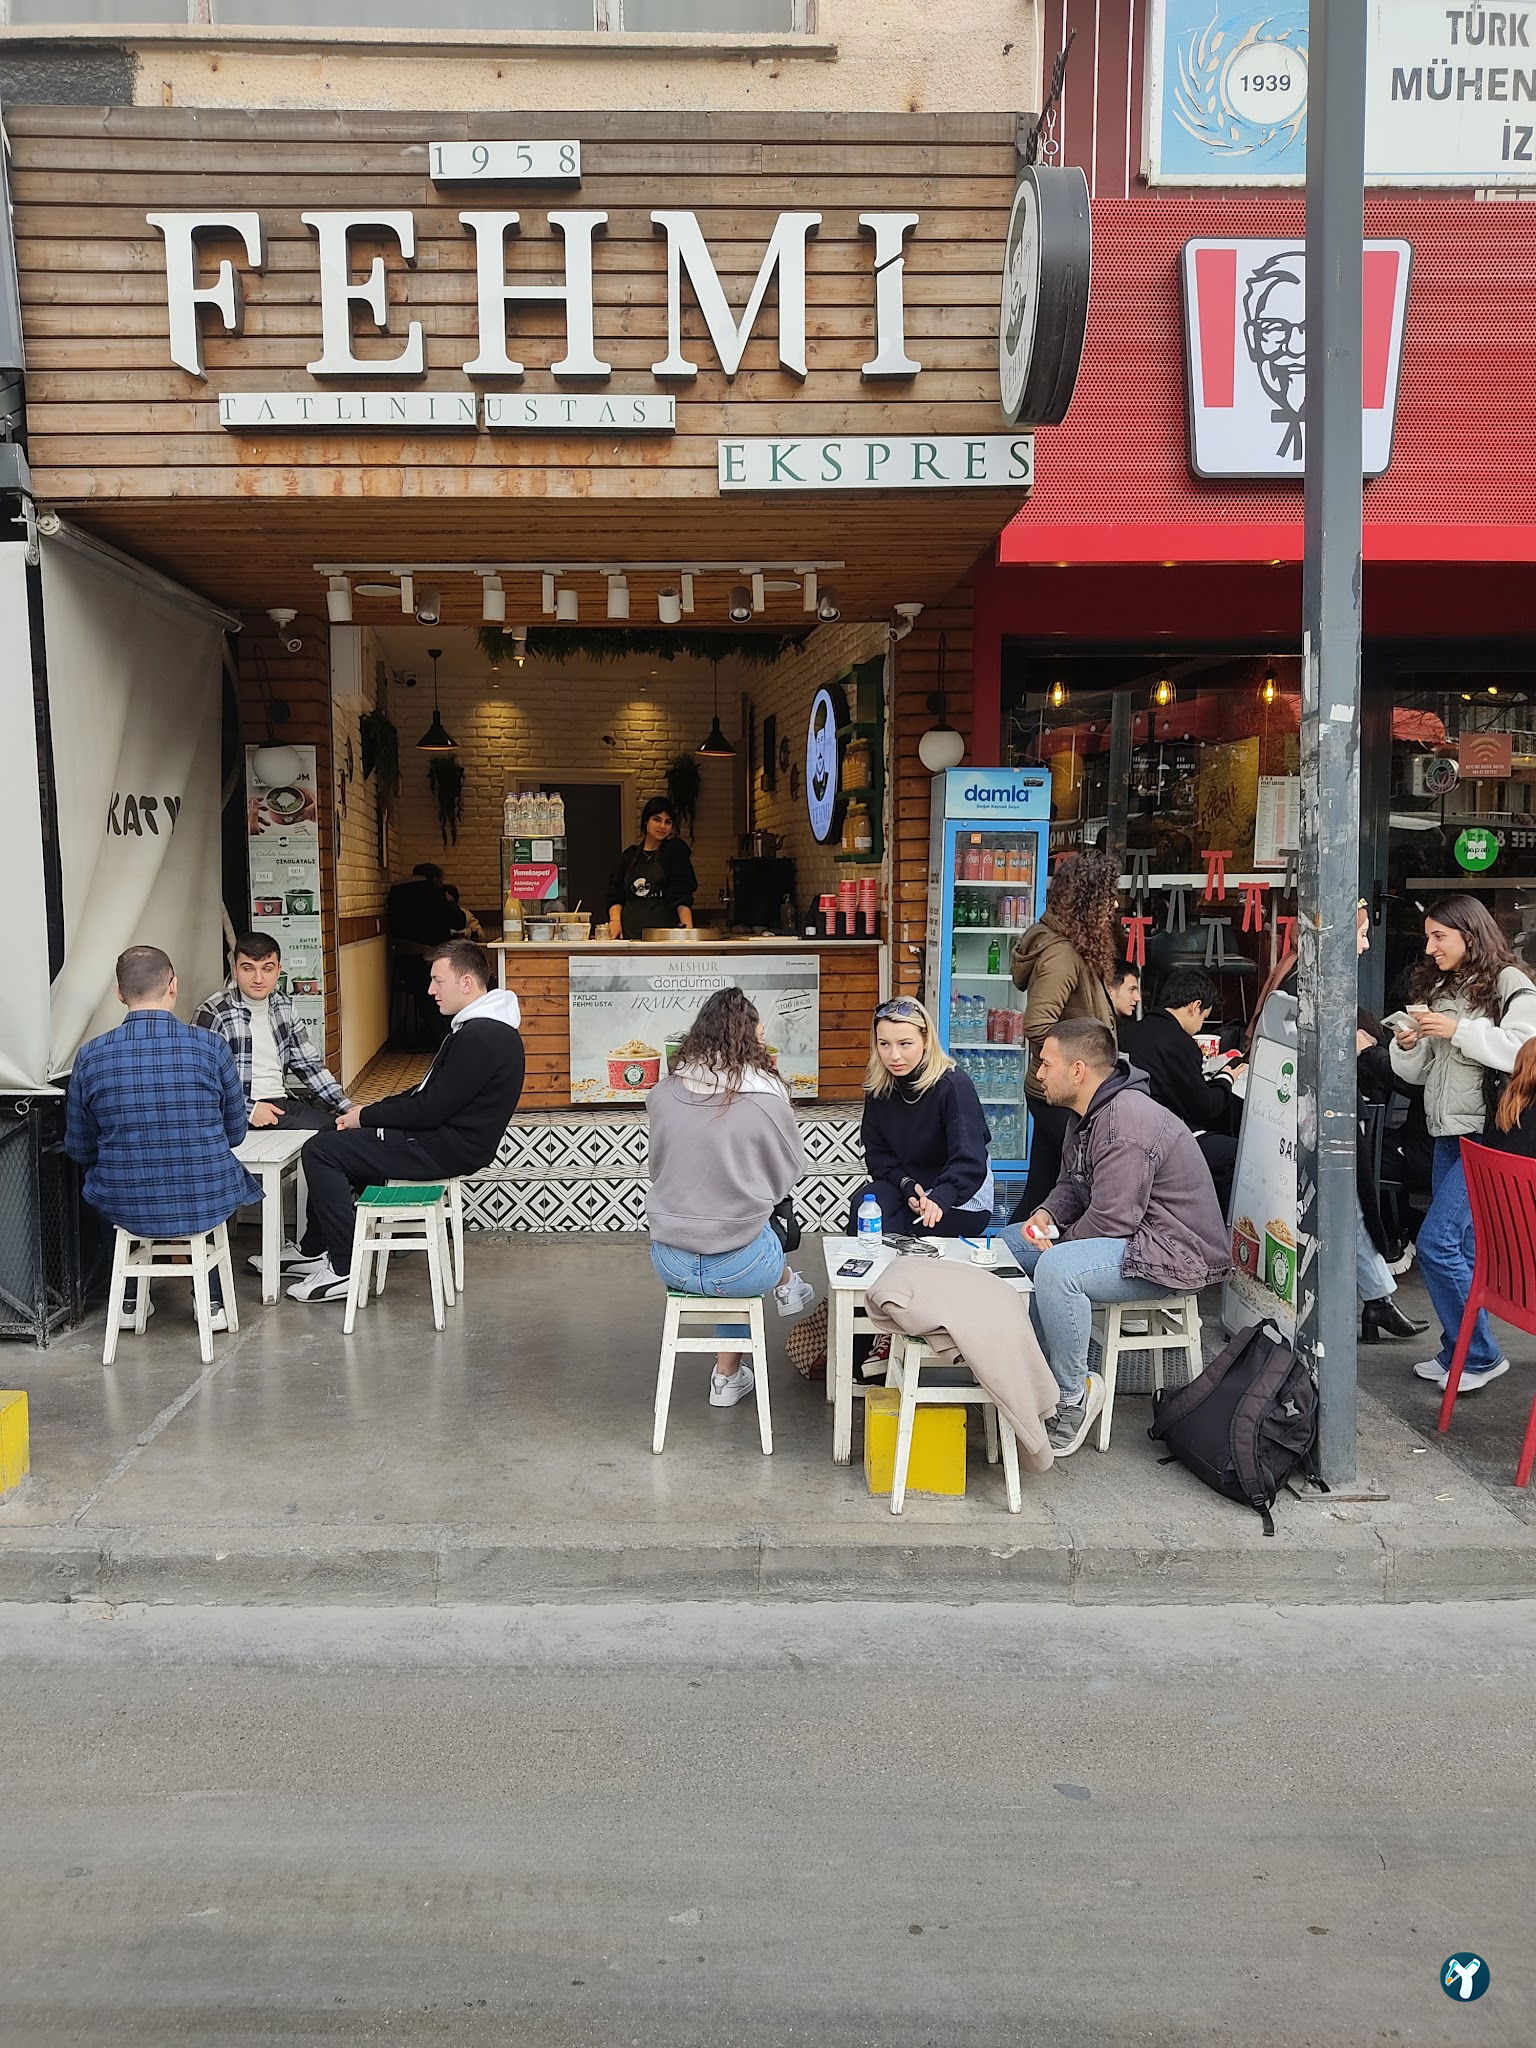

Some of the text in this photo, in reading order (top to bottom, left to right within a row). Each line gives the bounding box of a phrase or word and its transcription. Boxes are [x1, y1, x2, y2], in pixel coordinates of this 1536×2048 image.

[1446, 4, 1530, 47] TÜRK
[1240, 74, 1291, 92] 1939
[1391, 58, 1536, 102] MÜHEN
[432, 143, 578, 176] 1958
[219, 396, 675, 423] TATLININ USTASI
[722, 440, 1030, 483] EKSPRES
[964, 784, 1029, 803] damla
[513, 868, 550, 877] Yemeksepeti
[669, 961, 719, 973] MEŞHUR
[653, 976, 726, 988] dondurmalı
[631, 993, 687, 1012] İRMİK
